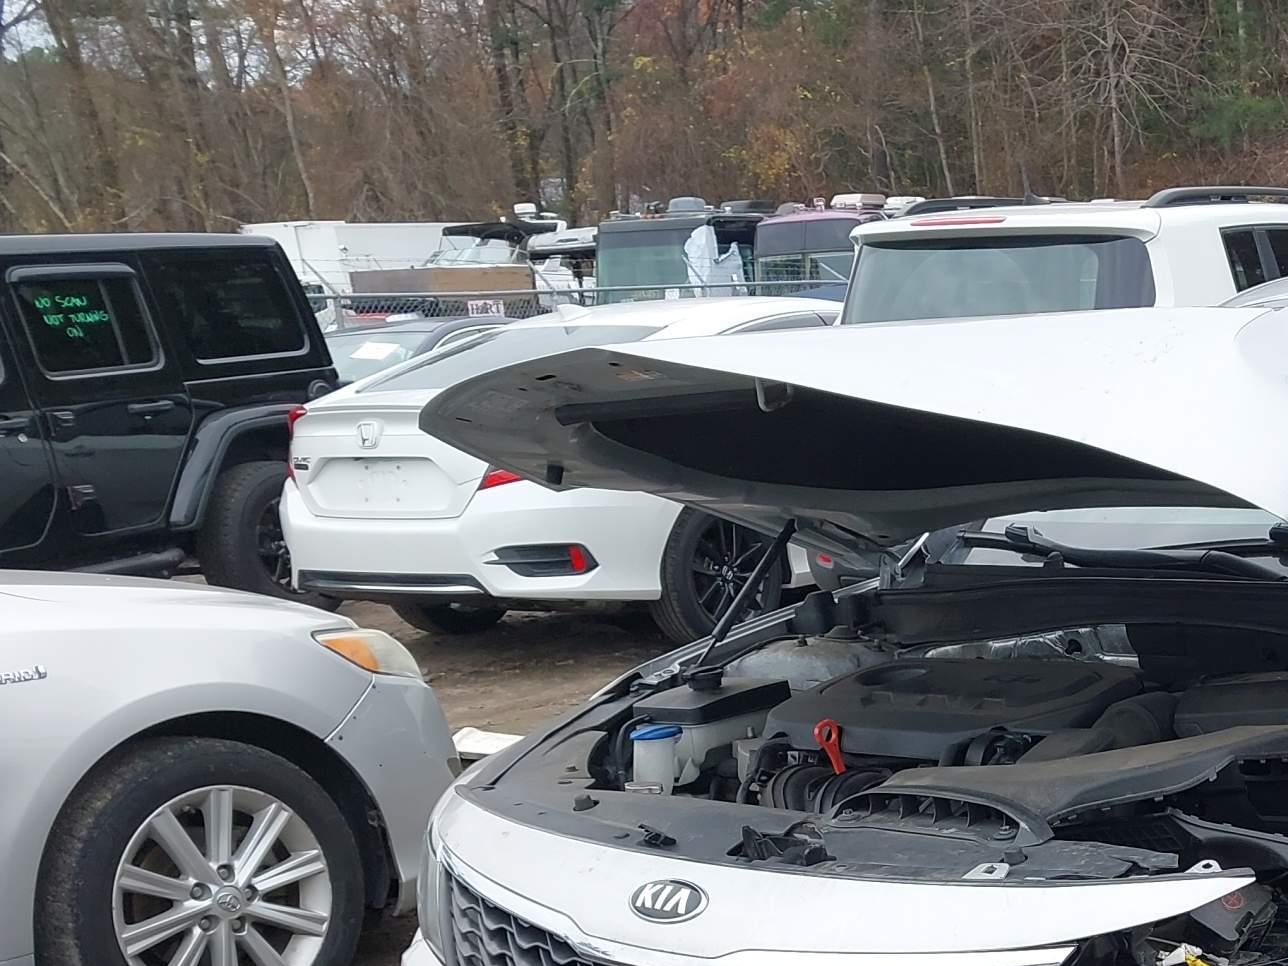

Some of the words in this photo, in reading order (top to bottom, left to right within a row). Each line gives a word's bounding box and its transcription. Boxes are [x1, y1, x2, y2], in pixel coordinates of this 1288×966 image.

[34, 296, 51, 309] NO
[55, 295, 87, 307] SCAN
[43, 313, 65, 326] NOT
[68, 310, 109, 324] TURNING
[66, 325, 83, 337] ON
[634, 883, 692, 915] KIA
